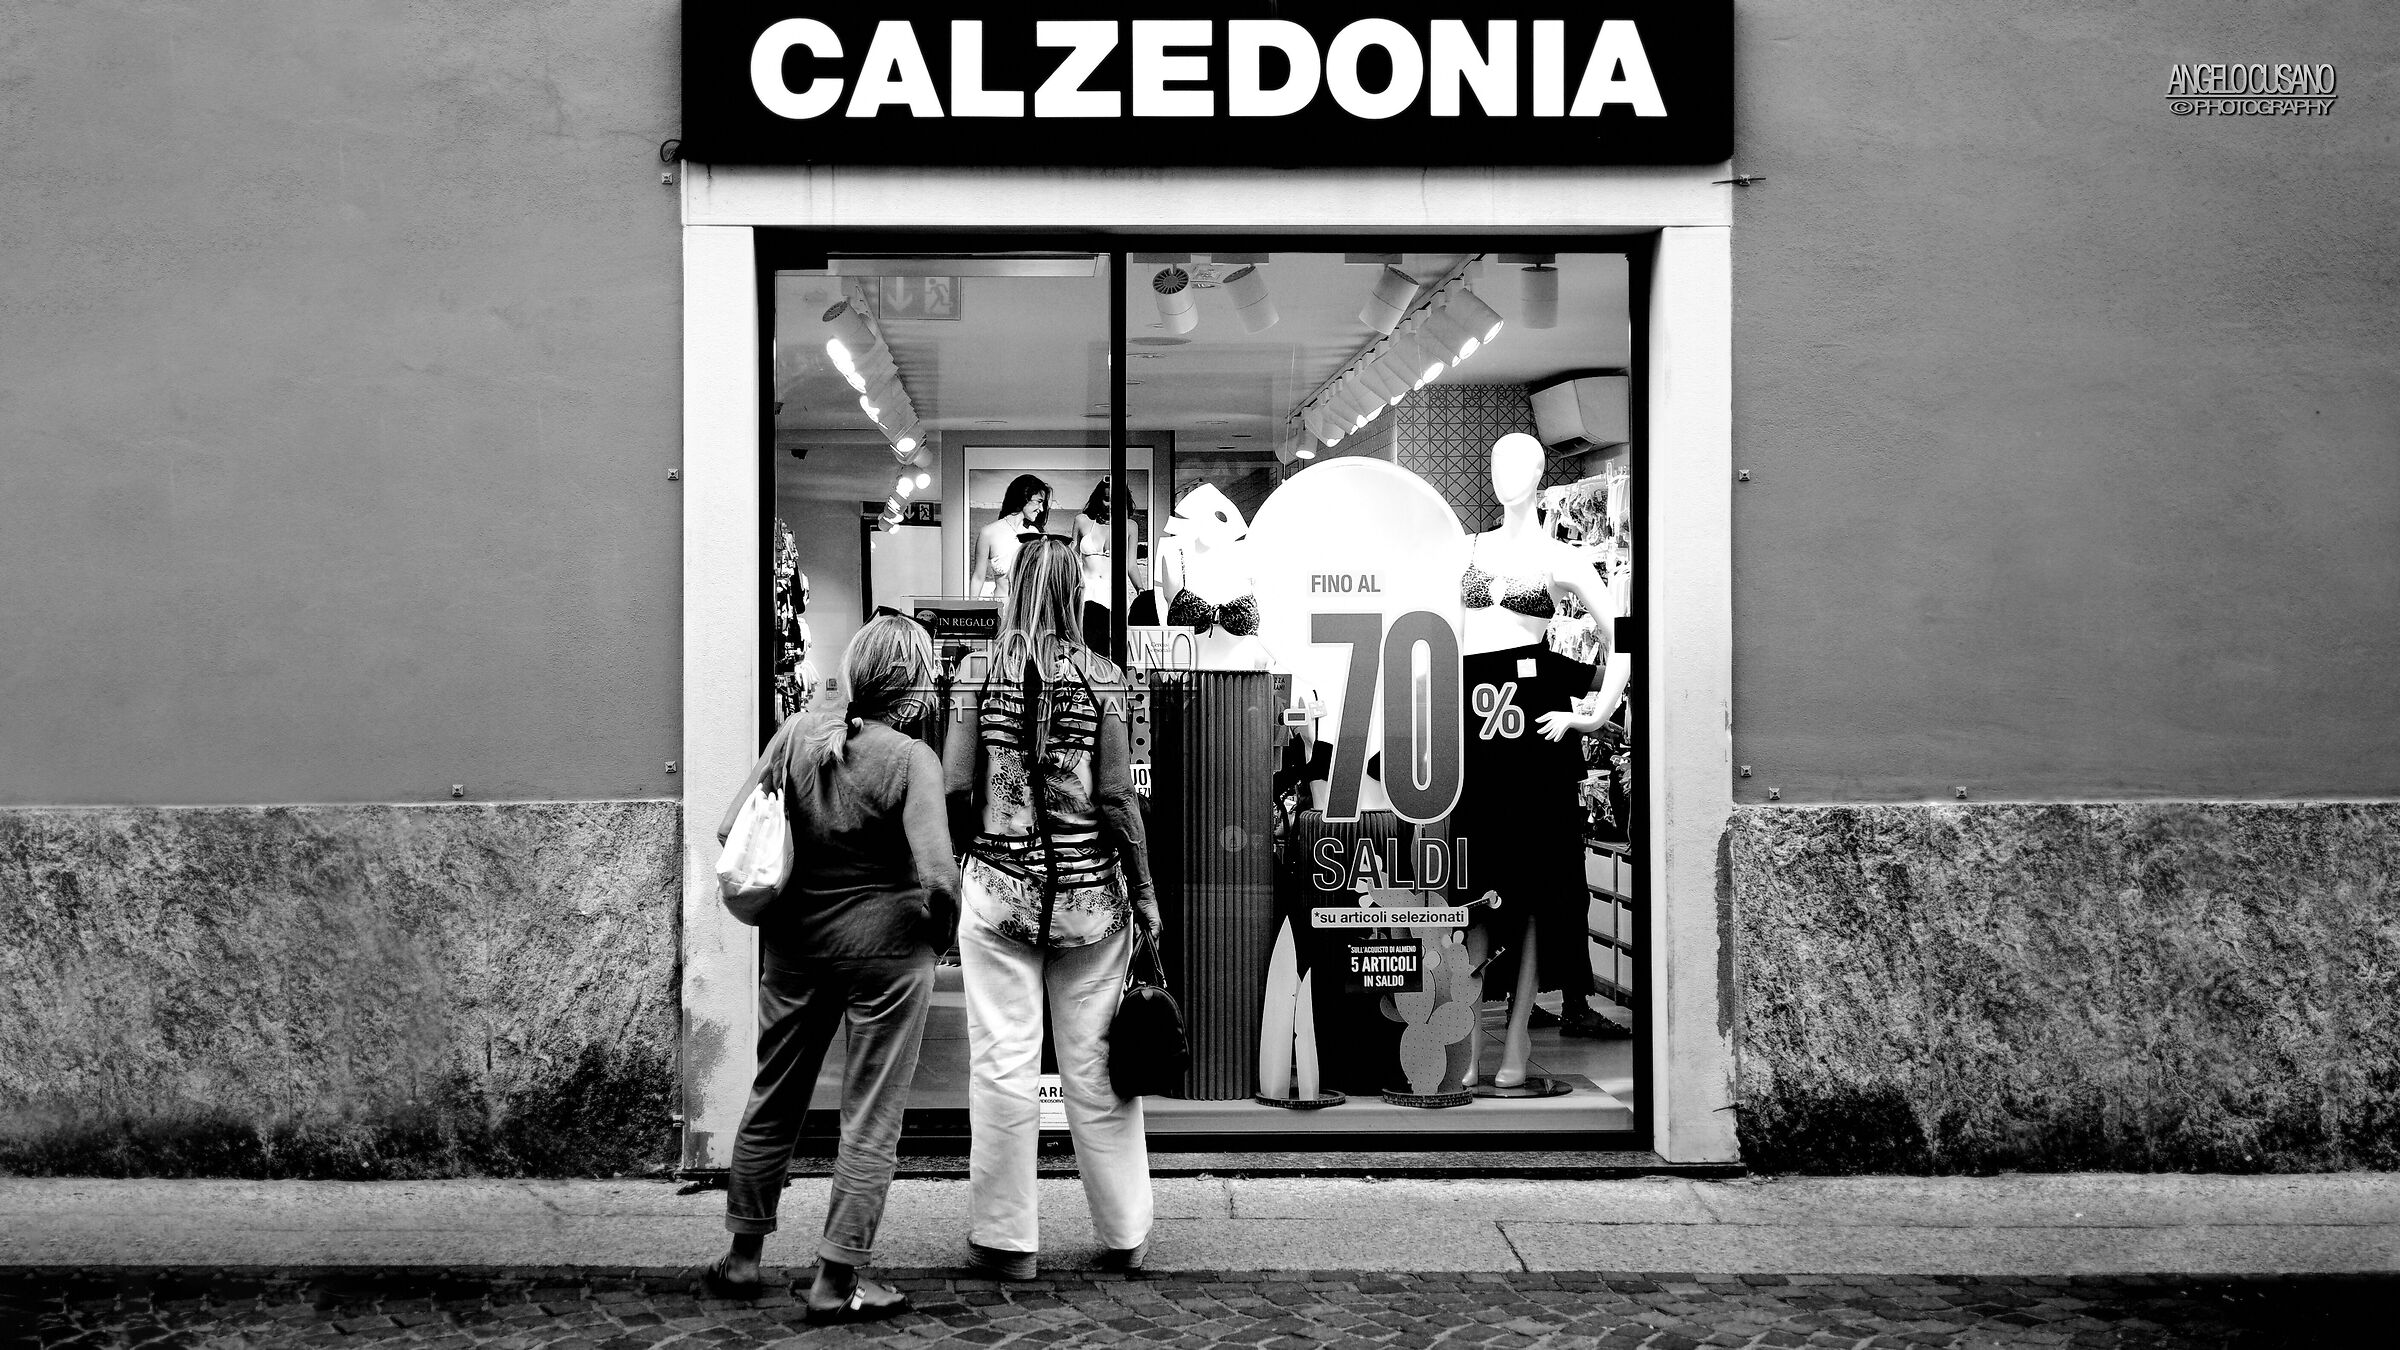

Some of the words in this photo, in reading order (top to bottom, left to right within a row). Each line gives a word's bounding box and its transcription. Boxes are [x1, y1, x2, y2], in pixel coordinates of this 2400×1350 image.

[749, 17, 1668, 120] CALZEDONIA
[1311, 574, 1352, 593] FINO
[1357, 574, 1381, 593] AL
[939, 617, 950, 626] IN
[1312, 837, 1469, 890] SALDI
[1340, 911, 1387, 924] articoli
[1391, 910, 1464, 923] selezionati
[1396, 945, 1416, 953] ALMENO
[1351, 956, 1359, 973] 5
[1362, 955, 1417, 973] ARTICOLI
[1364, 975, 1374, 987] IN
[1375, 974, 1404, 987] SALDO
